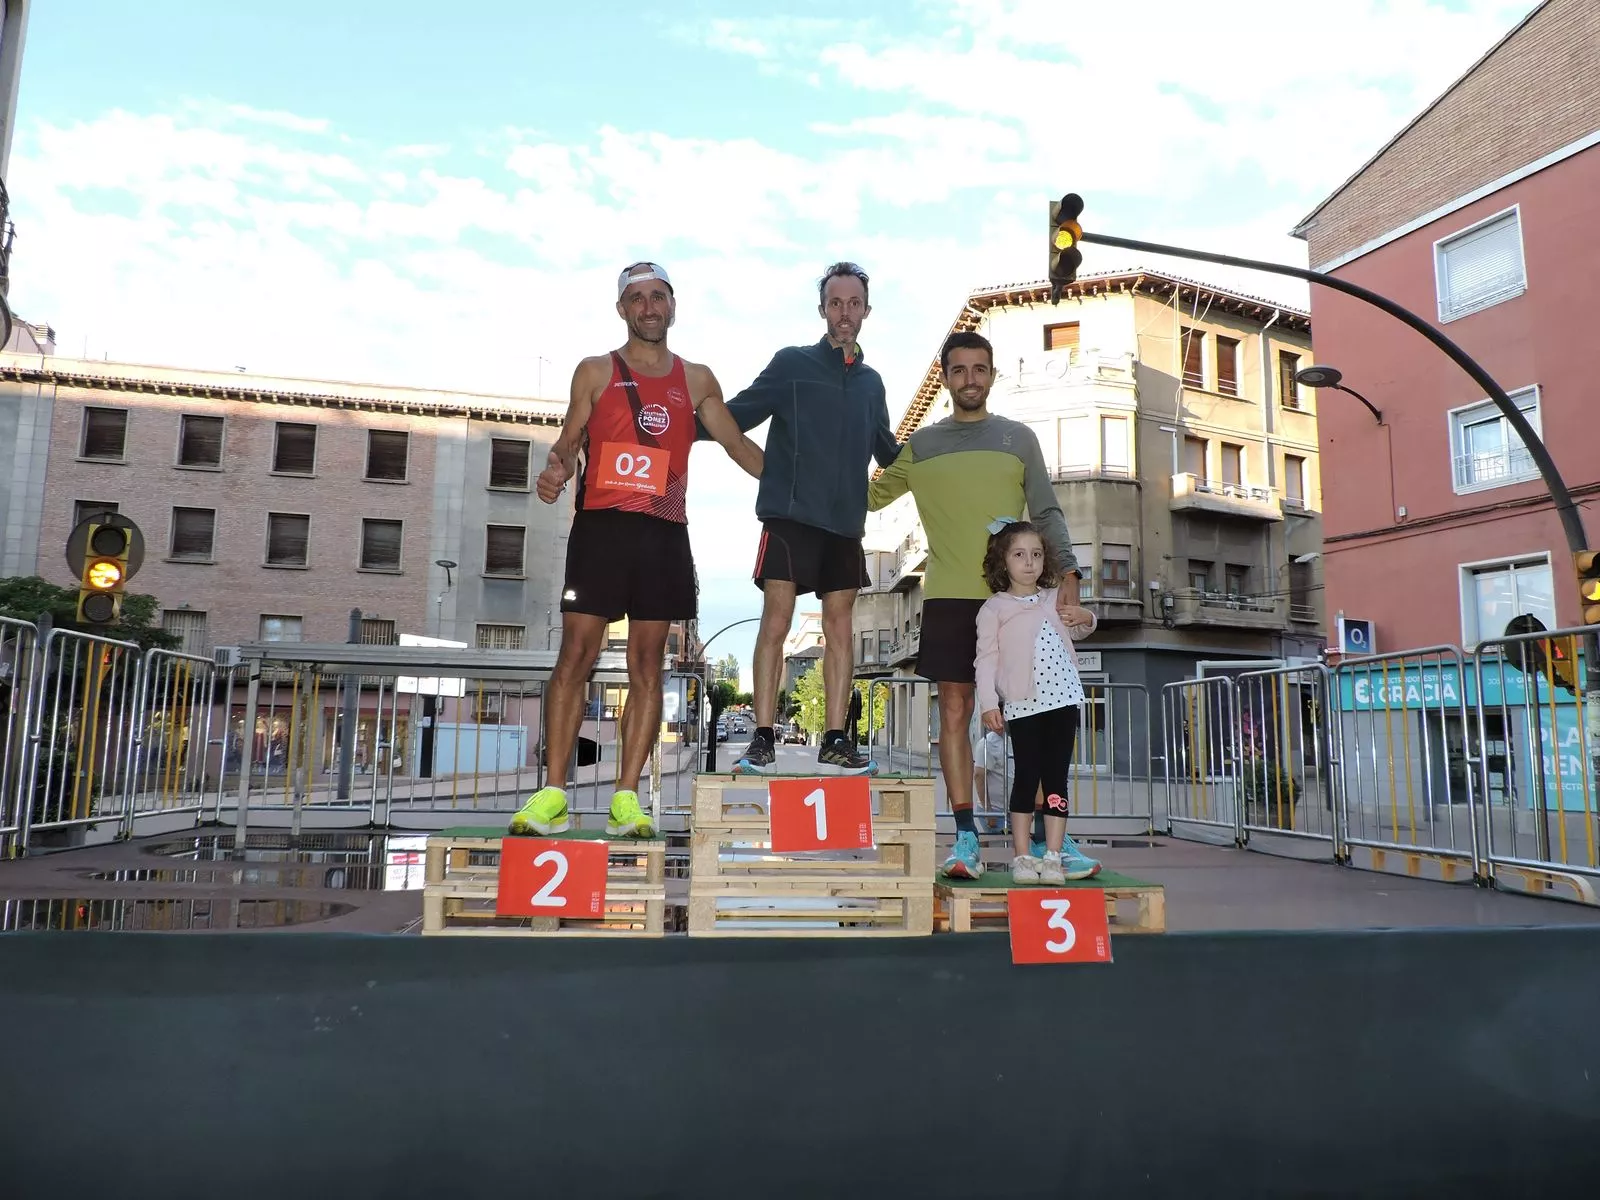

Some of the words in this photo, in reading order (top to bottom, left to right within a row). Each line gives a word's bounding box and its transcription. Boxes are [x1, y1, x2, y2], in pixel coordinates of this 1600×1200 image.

[615, 453, 651, 478] 02
[1535, 754, 1595, 776] REN
[803, 788, 828, 841] 1
[530, 850, 568, 906] 2
[1040, 899, 1076, 953] 3
